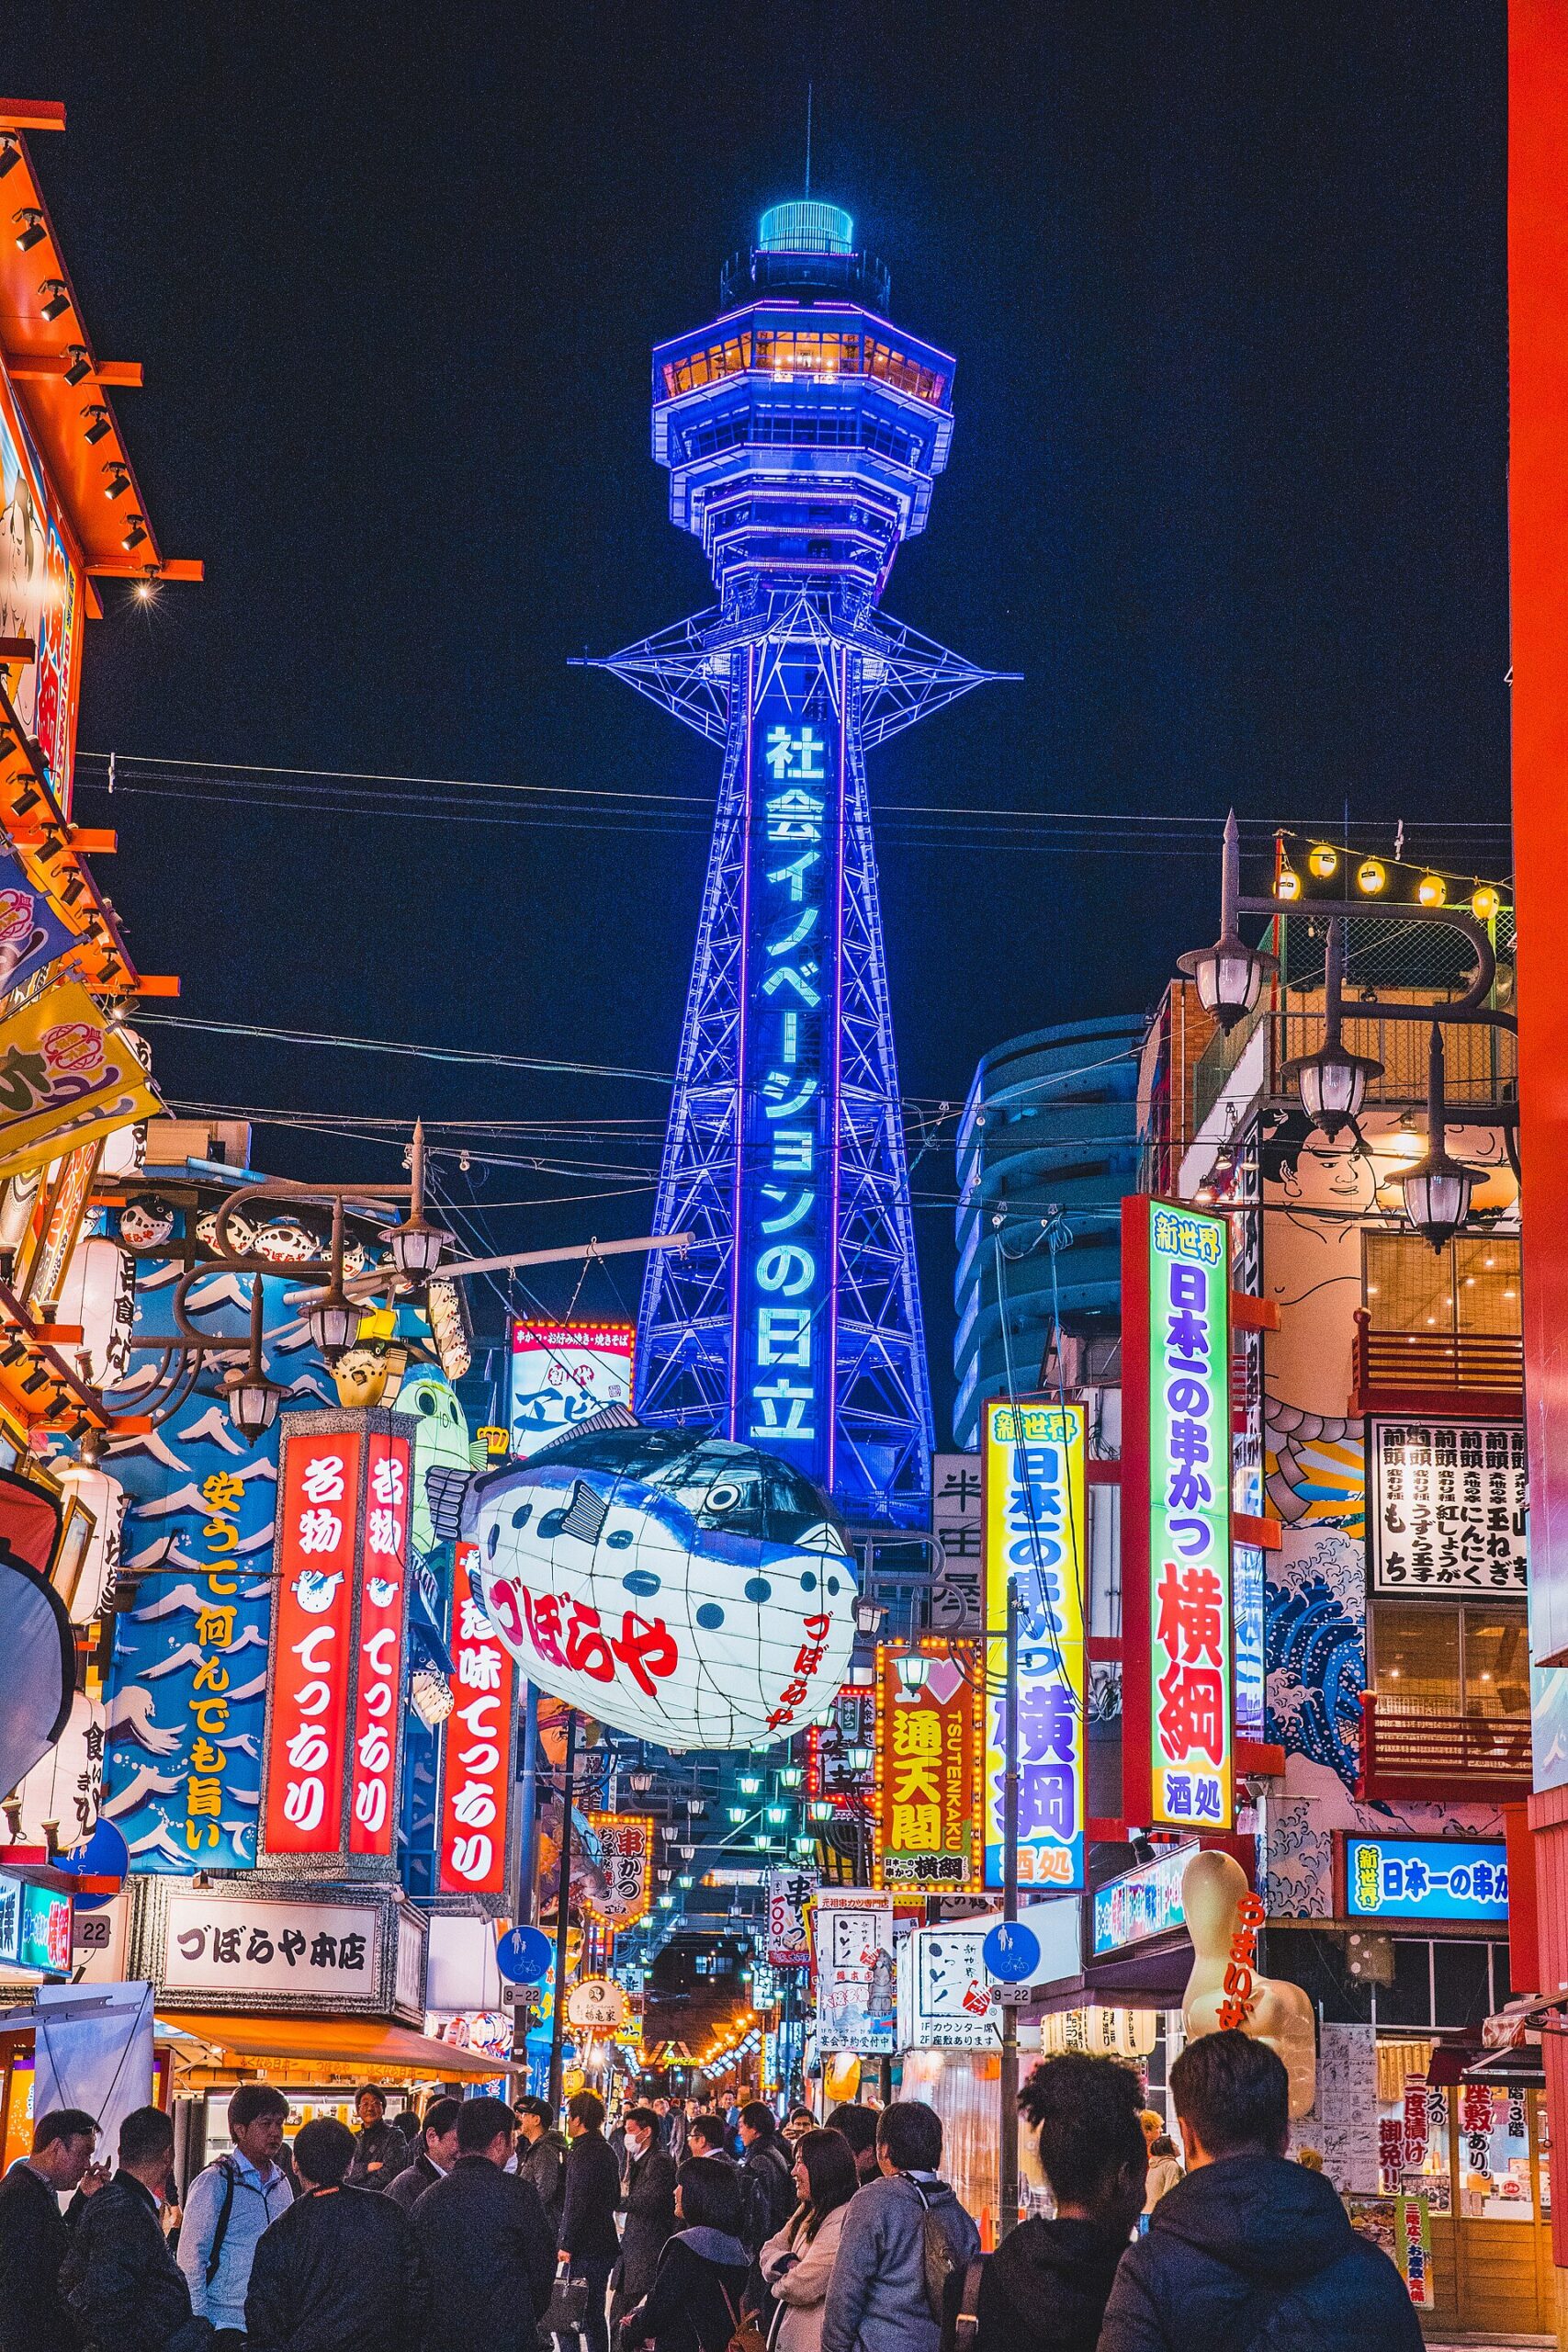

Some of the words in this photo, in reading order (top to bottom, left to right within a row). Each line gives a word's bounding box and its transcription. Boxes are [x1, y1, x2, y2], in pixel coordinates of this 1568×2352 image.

[753, 724, 825, 1440] 社会イノベーションの日立
[1155, 1209, 1220, 1262] 新世界
[995, 1410, 1077, 1442] 新世界
[1167, 1265, 1211, 1555] 日本一の串かつ
[1383, 1429, 1405, 1466] 前頭
[1435, 1430, 1458, 1468] 前頭
[1461, 1430, 1483, 1470] 前頭
[1485, 1431, 1508, 1470] 前頭
[299, 1456, 344, 1554] 名物
[369, 1458, 405, 1555] 名物
[1384, 1503, 1406, 1582] もち
[1411, 1504, 1435, 1583] うずら玉子
[1436, 1505, 1461, 1583] 紅しょうが
[1461, 1507, 1484, 1585] にんにく
[1486, 1507, 1512, 1586] 玉ねぎ
[187, 1472, 245, 1850] 安うて何んでも旨い
[491, 1577, 678, 1697] づぼらや
[766, 1612, 834, 1731] づぼらや
[1156, 1565, 1224, 1766] 横綱
[285, 1626, 333, 1832] てっちり
[355, 1628, 394, 1834] てっちり
[992, 1685, 1076, 1837] 横綱
[891, 1710, 942, 1850] 通天閣
[946, 1710, 963, 1849] TSUTENKAKU
[1166, 1775, 1220, 1819] 酒処
[617, 1828, 645, 1899] 串かつ
[885, 1858, 914, 1867] 日本一の
[915, 1857, 963, 1880] 横綱
[885, 1867, 914, 1878] 串かつ
[1010, 1849, 1071, 1882] 酒処
[1358, 1849, 1378, 1907] 新世界
[177, 1925, 367, 1970] づぼらや本店
[820, 2035, 889, 2048] 宴会予約受付中
[933, 2035, 994, 2047] 座敷あります
[1404, 2074, 1427, 2164] 二度漬け
